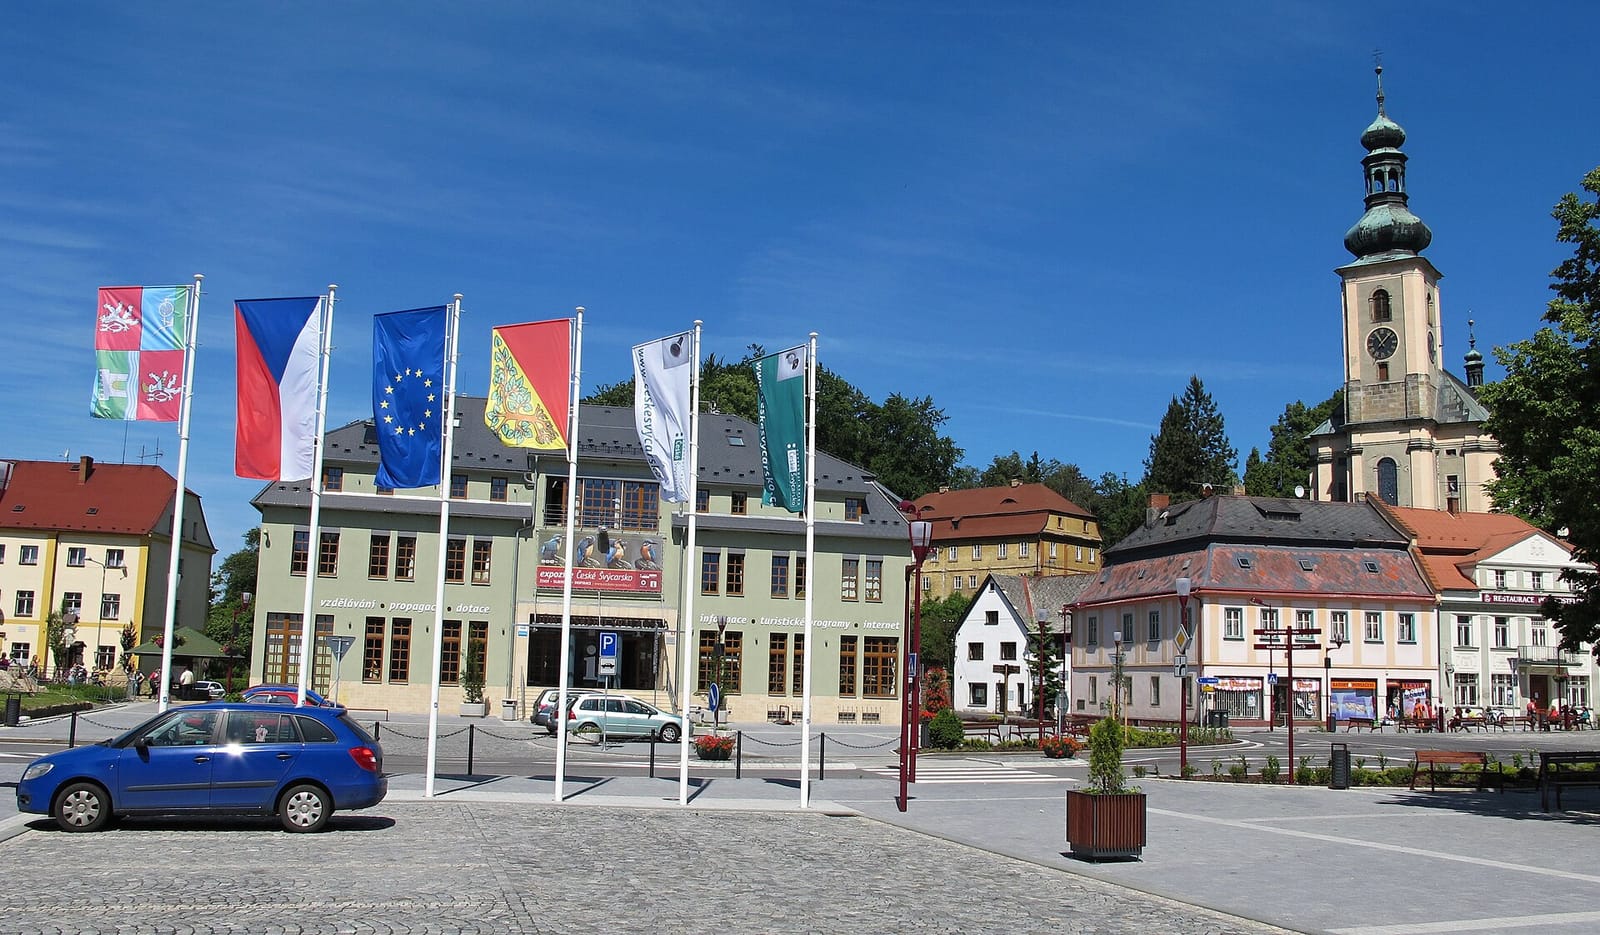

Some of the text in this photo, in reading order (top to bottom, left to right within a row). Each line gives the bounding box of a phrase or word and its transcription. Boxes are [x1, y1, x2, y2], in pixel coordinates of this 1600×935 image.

[540, 571, 573, 580] expoz
[320, 597, 490, 614] vzdělávání propagac dotace
[1493, 595, 1535, 604] RESTAURACE
[699, 613, 748, 625] infoace
[812, 619, 851, 630] rogramy
[863, 619, 900, 630] internet
[603, 636, 613, 650] P
